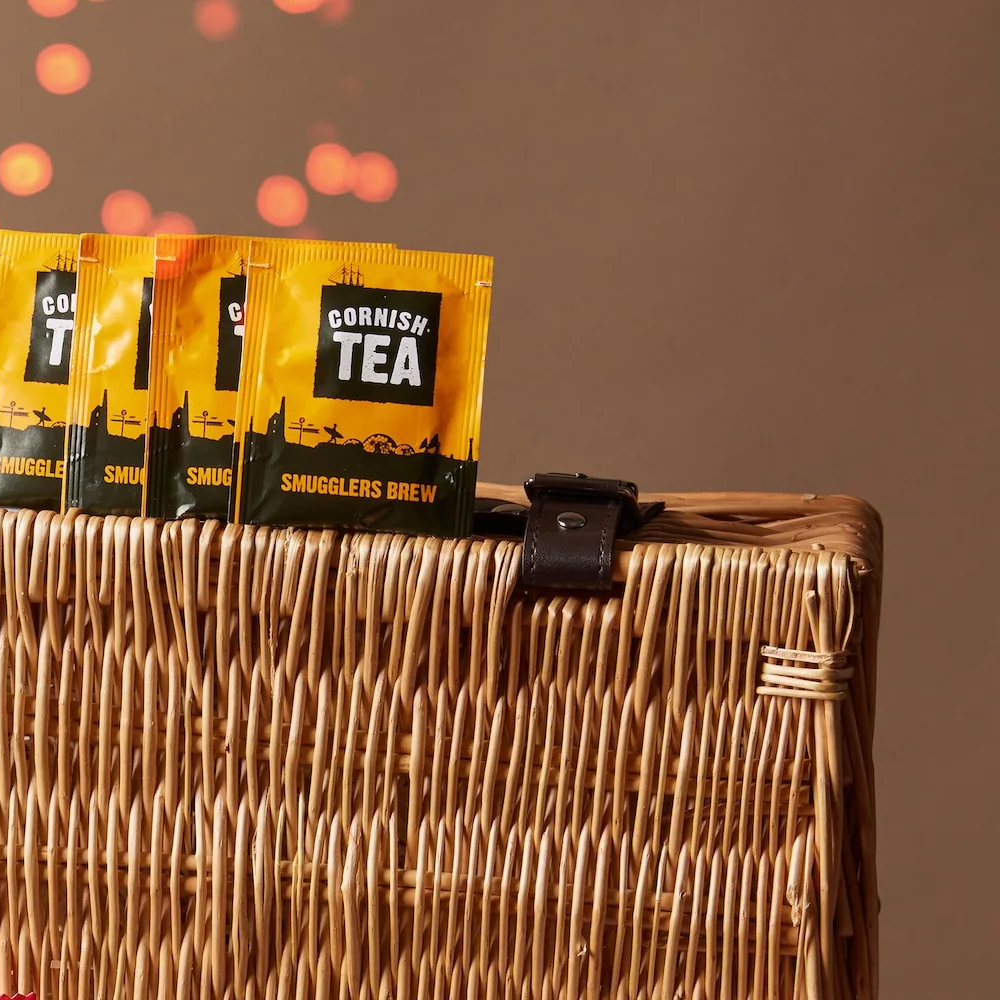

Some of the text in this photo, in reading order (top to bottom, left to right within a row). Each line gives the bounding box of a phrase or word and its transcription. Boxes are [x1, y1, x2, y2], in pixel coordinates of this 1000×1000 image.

[328, 307, 428, 336] CORNISH
[333, 331, 421, 387] TEA
[186, 467, 233, 487] SMUG
[280, 473, 438, 504] SMUGGLERS BREW
